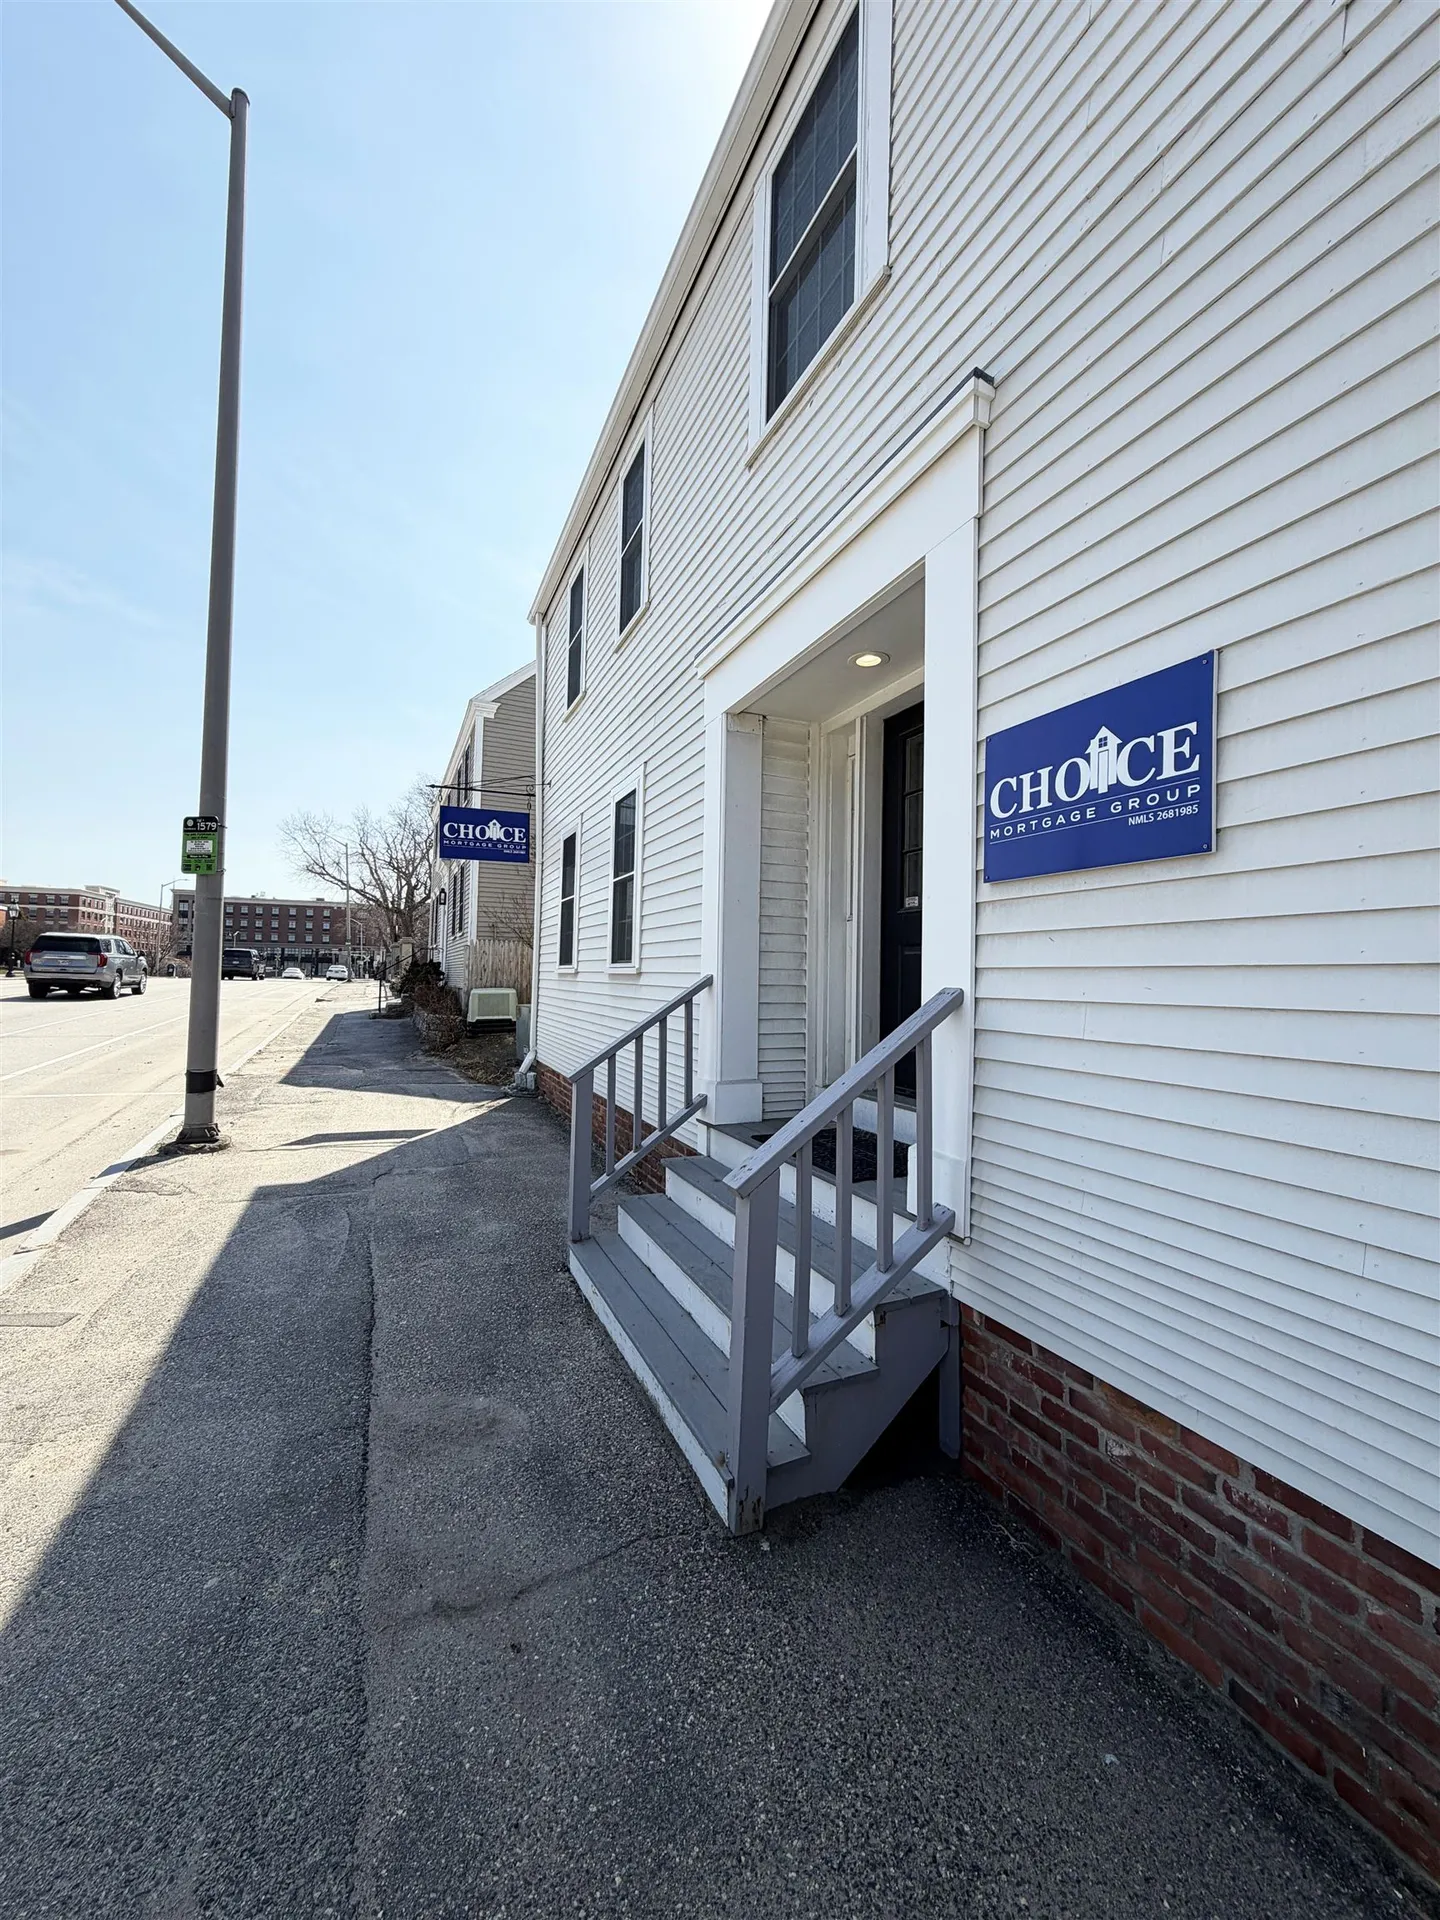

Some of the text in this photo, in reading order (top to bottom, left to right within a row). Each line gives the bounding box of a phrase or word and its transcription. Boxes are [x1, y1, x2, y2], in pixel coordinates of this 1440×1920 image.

[989, 721, 1200, 819] CHOICE
[990, 784, 1201, 839] MORTGAGE GROUP
[1128, 804, 1199, 826] NMLS 2681985
[197, 822, 217, 831] 1579
[443, 819, 526, 843] CHOICE
[443, 840, 492, 848] MORTGAGE
